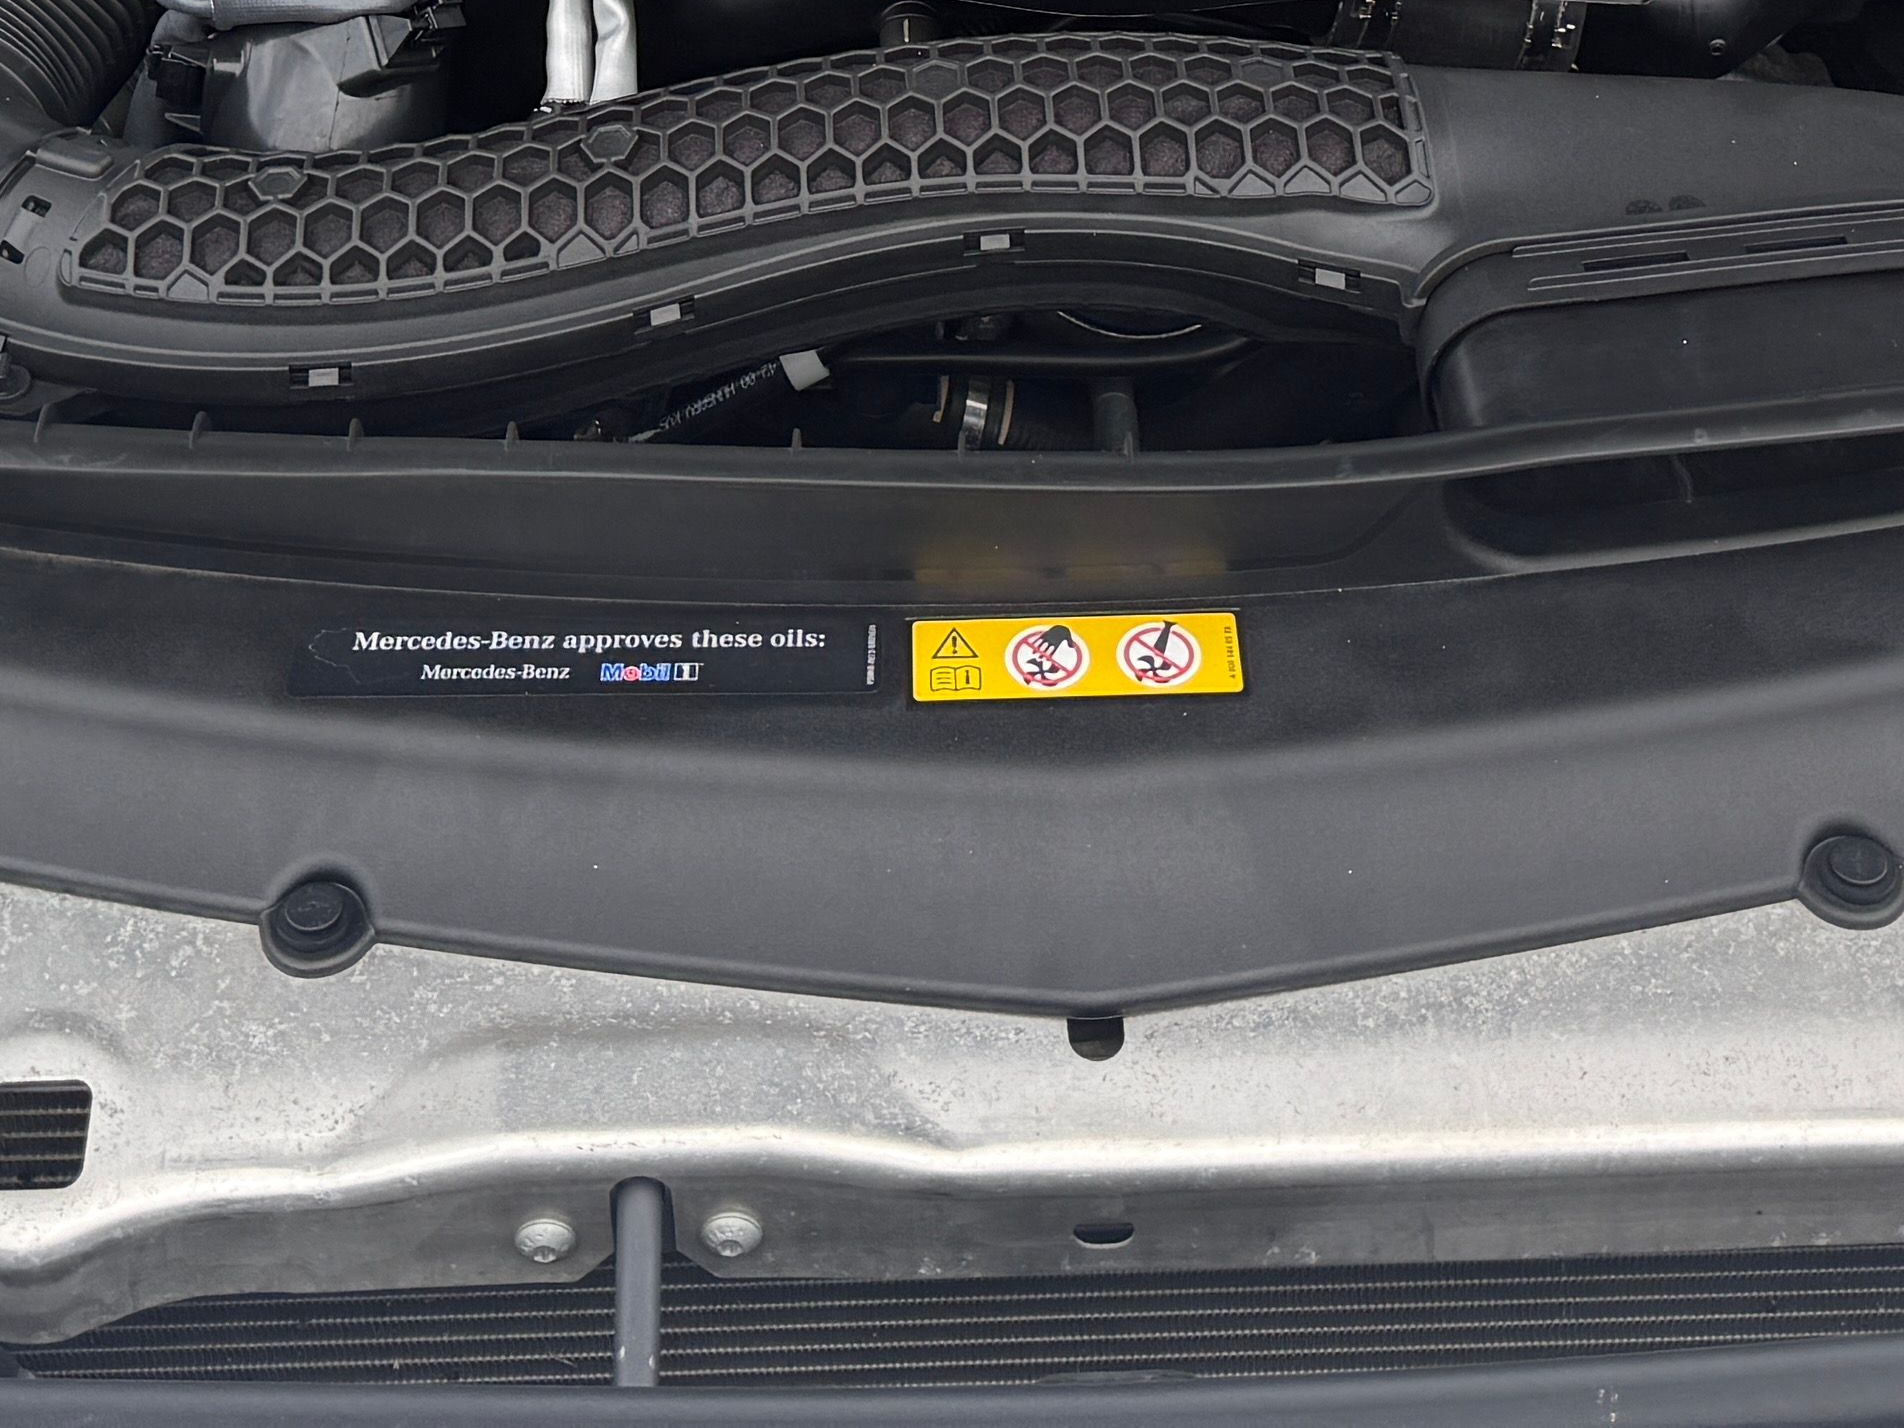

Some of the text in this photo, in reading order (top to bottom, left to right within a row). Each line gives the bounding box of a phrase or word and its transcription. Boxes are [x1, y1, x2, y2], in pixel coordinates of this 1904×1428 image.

[352, 628, 826, 654] Mercedes-Benz approves these oils:
[420, 663, 571, 680] Mercedes-Benz
[600, 662, 672, 682] Mobil
